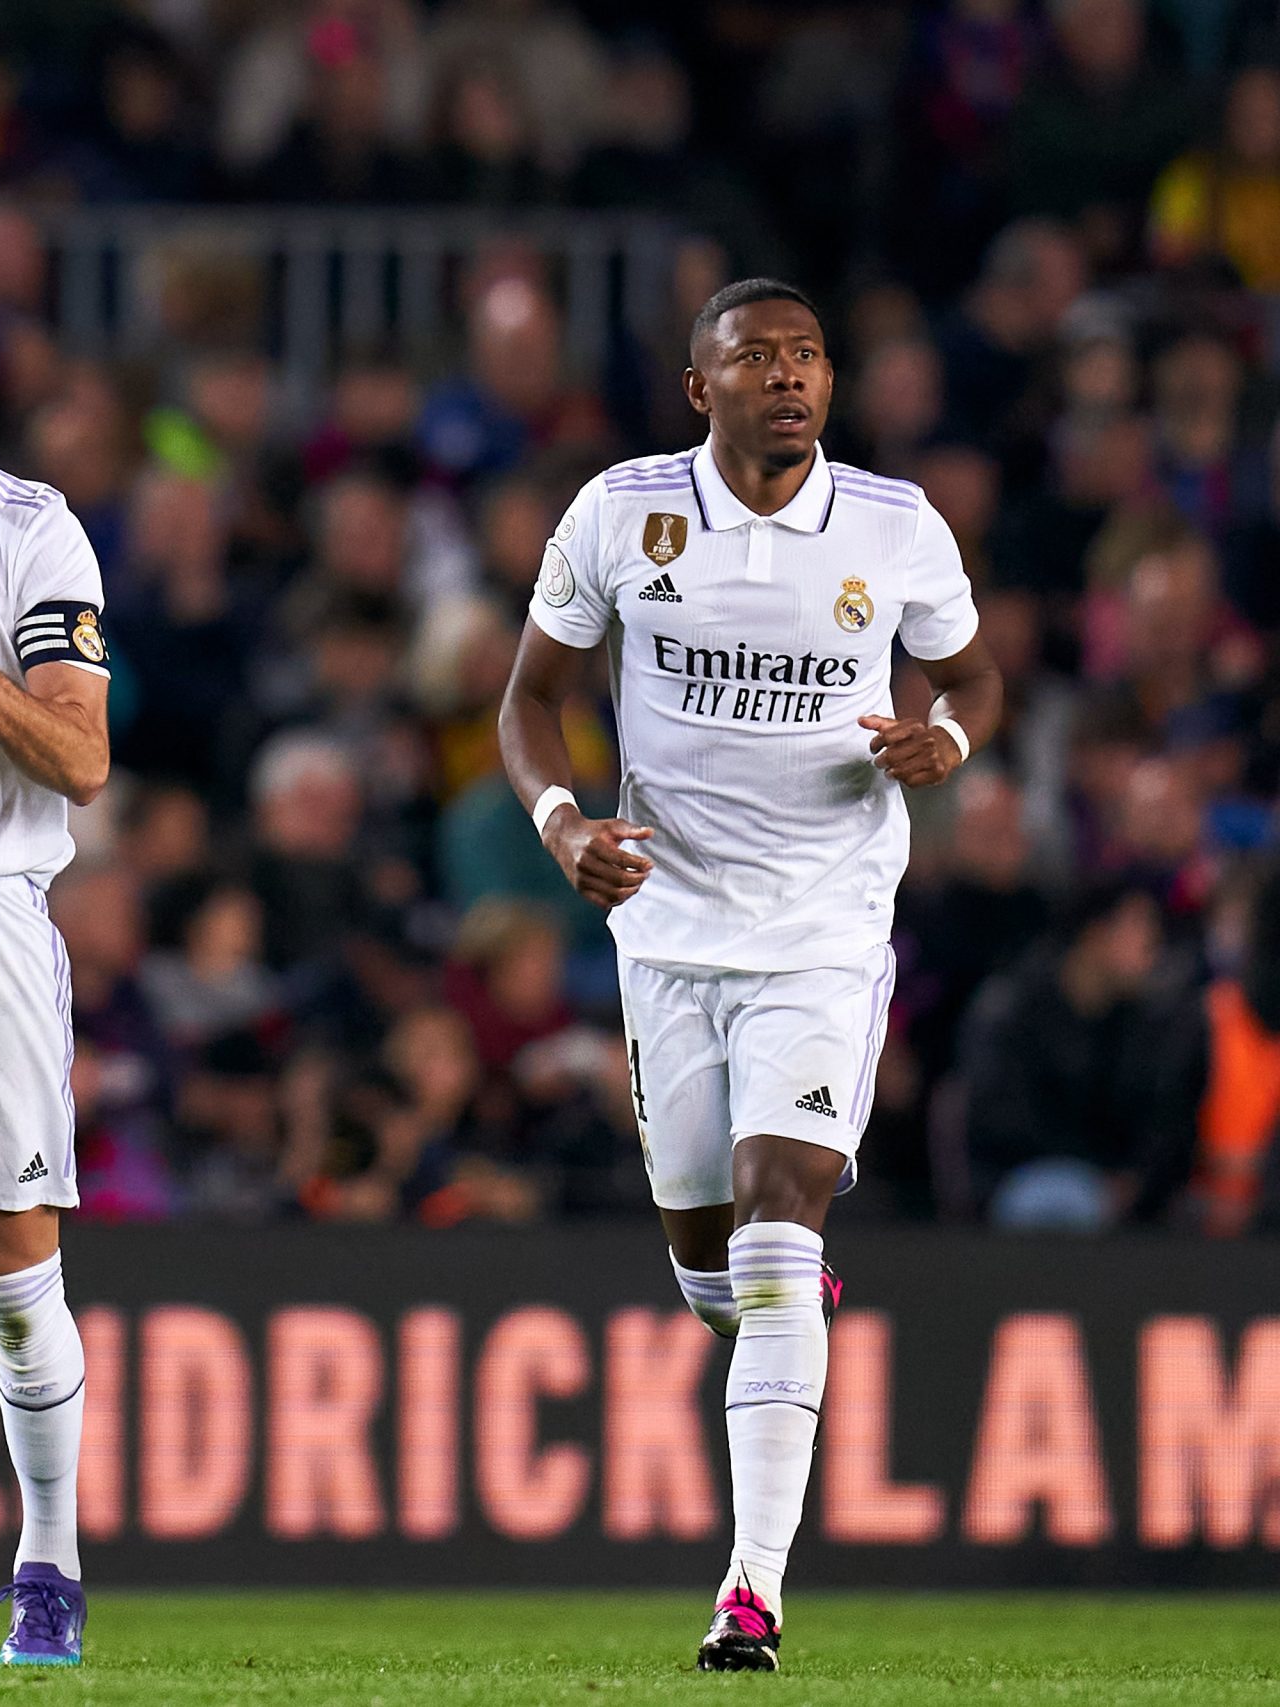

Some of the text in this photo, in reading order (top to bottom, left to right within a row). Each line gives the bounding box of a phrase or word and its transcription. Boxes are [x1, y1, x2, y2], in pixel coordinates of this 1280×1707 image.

[652, 545, 674, 554] FIFA
[638, 588, 683, 603] adidas
[652, 634, 860, 687] Emirates
[681, 682, 826, 723] FLY BETTER
[795, 1099, 838, 1119] adidas
[18, 1167, 49, 1184] adidas
[822, 1307, 1280, 1550] LAM
